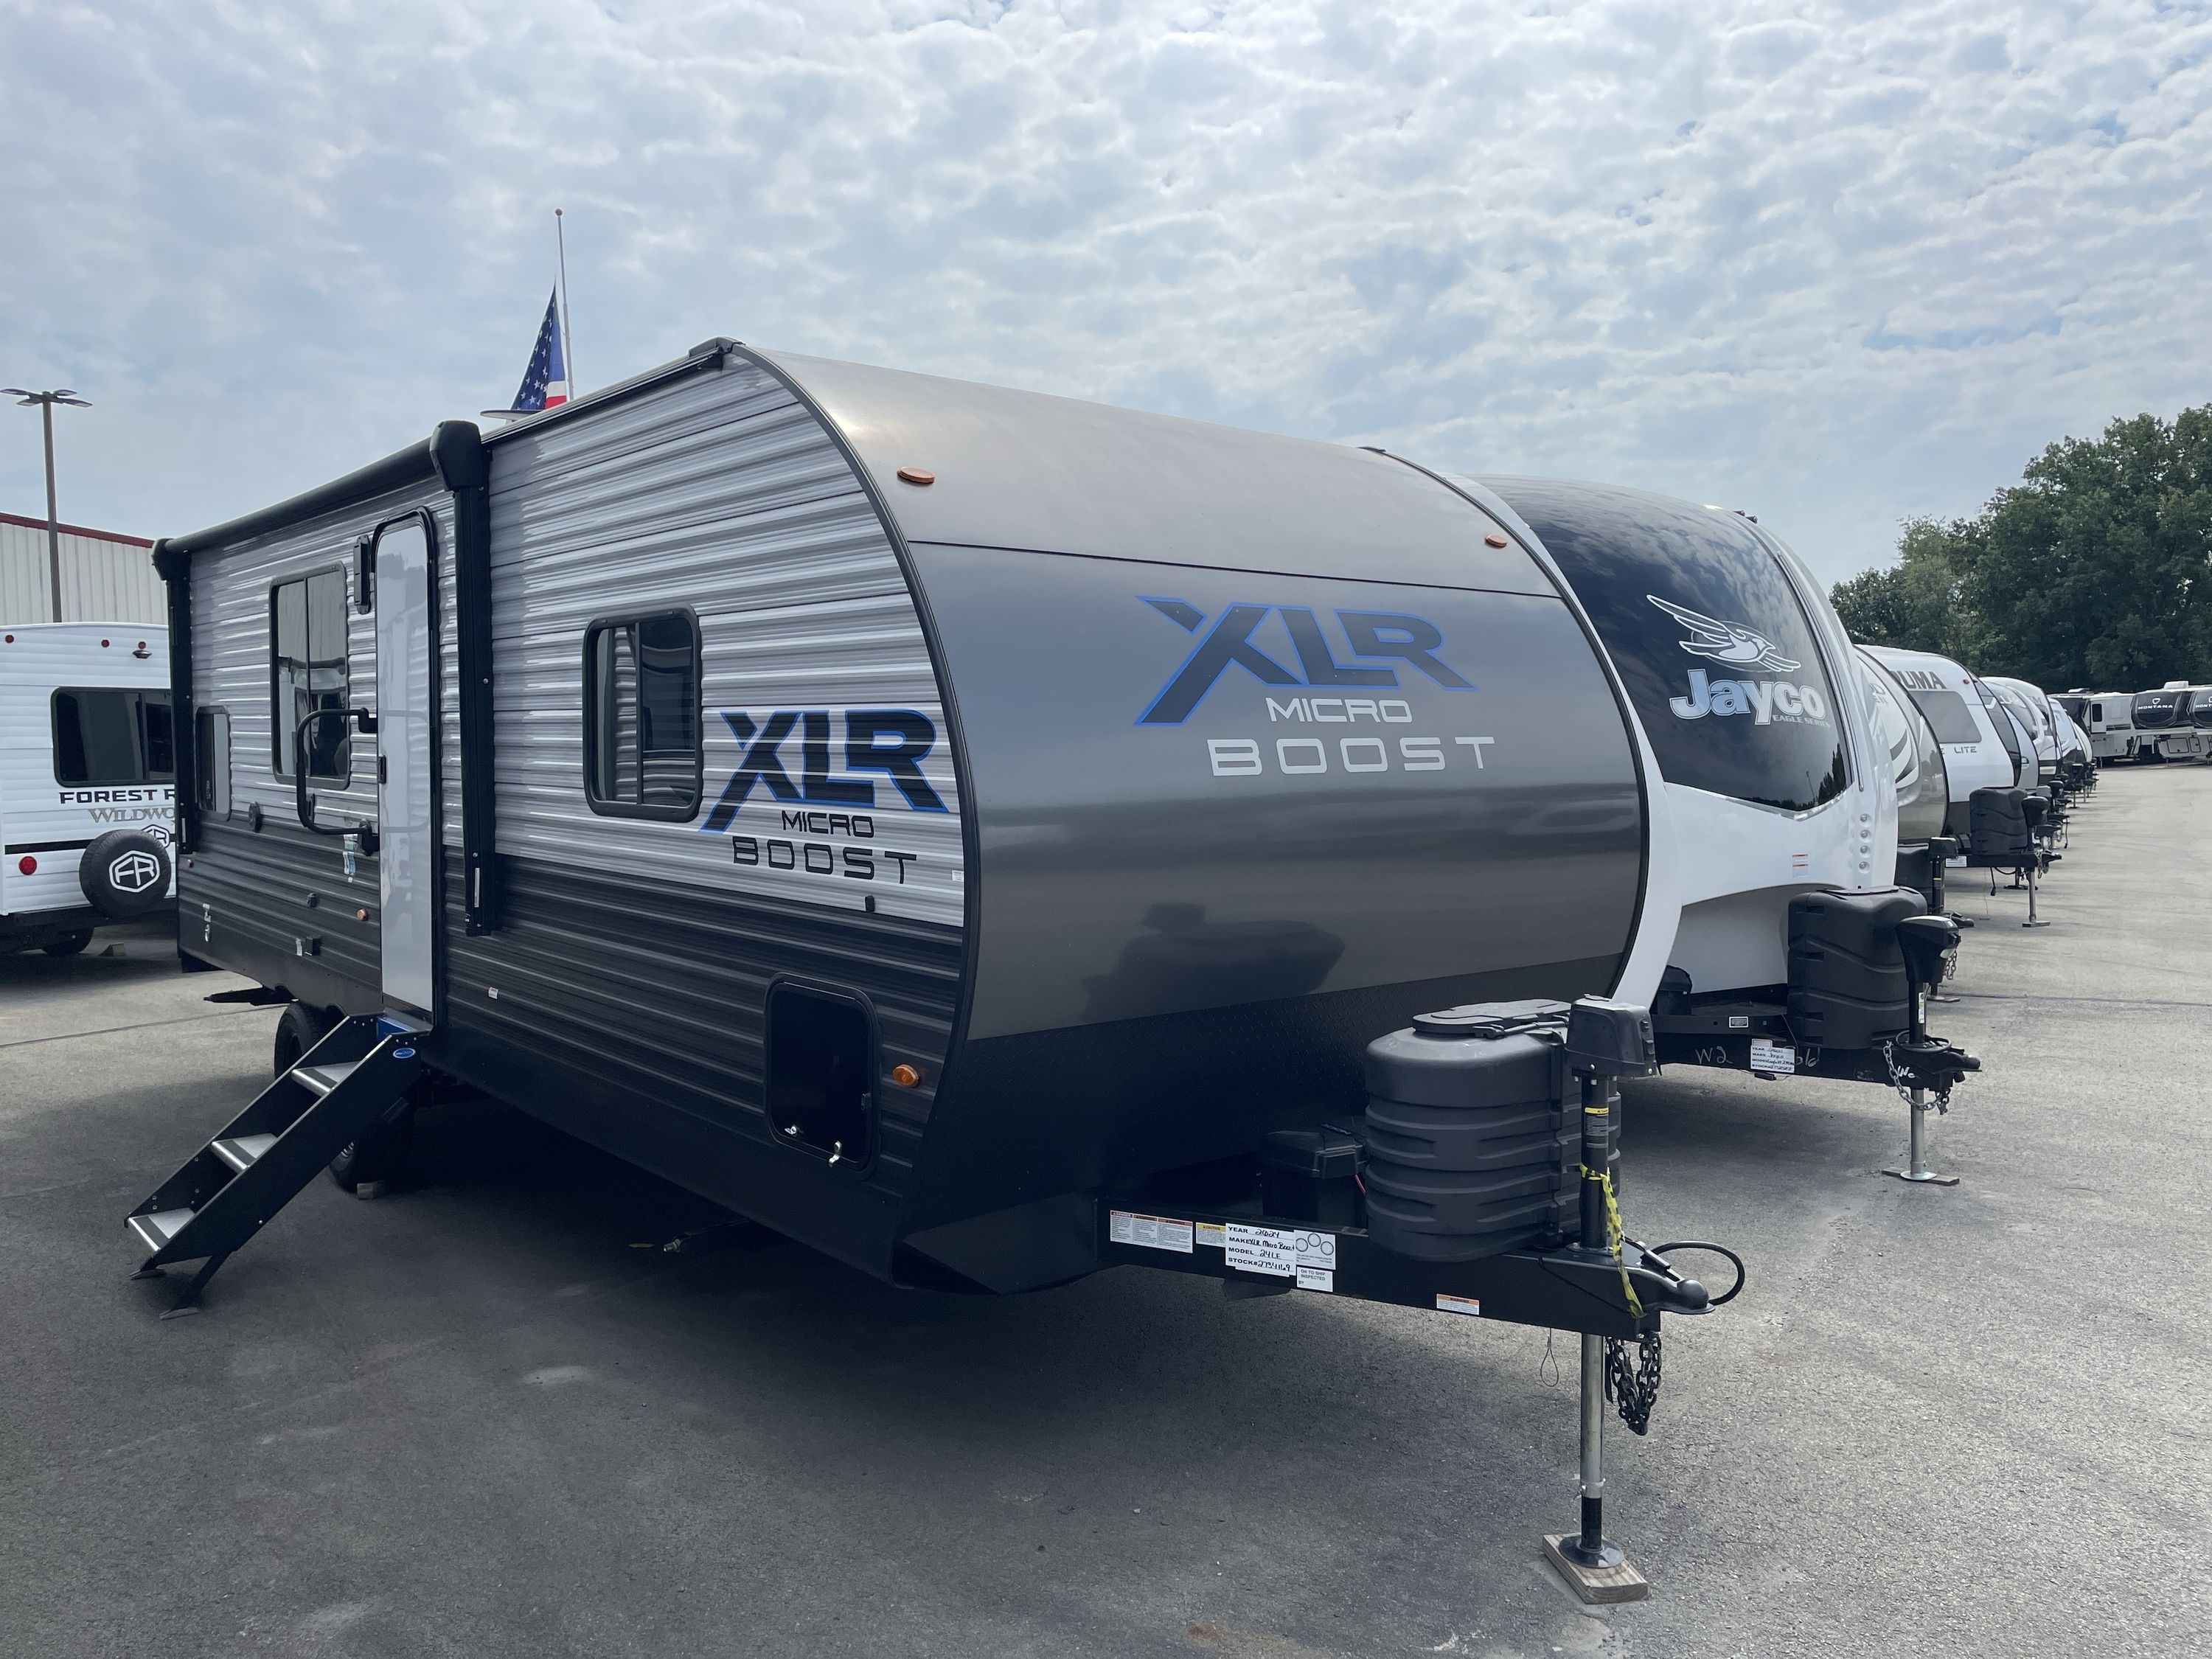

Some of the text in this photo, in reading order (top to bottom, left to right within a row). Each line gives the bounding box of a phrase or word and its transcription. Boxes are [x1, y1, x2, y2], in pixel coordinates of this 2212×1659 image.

[1133, 595, 1480, 726] XLR
[1265, 698, 1413, 723] MICRO
[1669, 668, 1826, 726] Jayco
[1772, 714, 1831, 728] EAGLE SERIES
[698, 709, 950, 832] XLR
[1207, 737, 1495, 776] BOOST
[59, 789, 157, 804] FOREST
[782, 810, 874, 838] MICRO
[732, 836, 917, 885] BOOST
[1228, 1237, 1250, 1245] MAKE
[1228, 1247, 1254, 1255] MODEL
